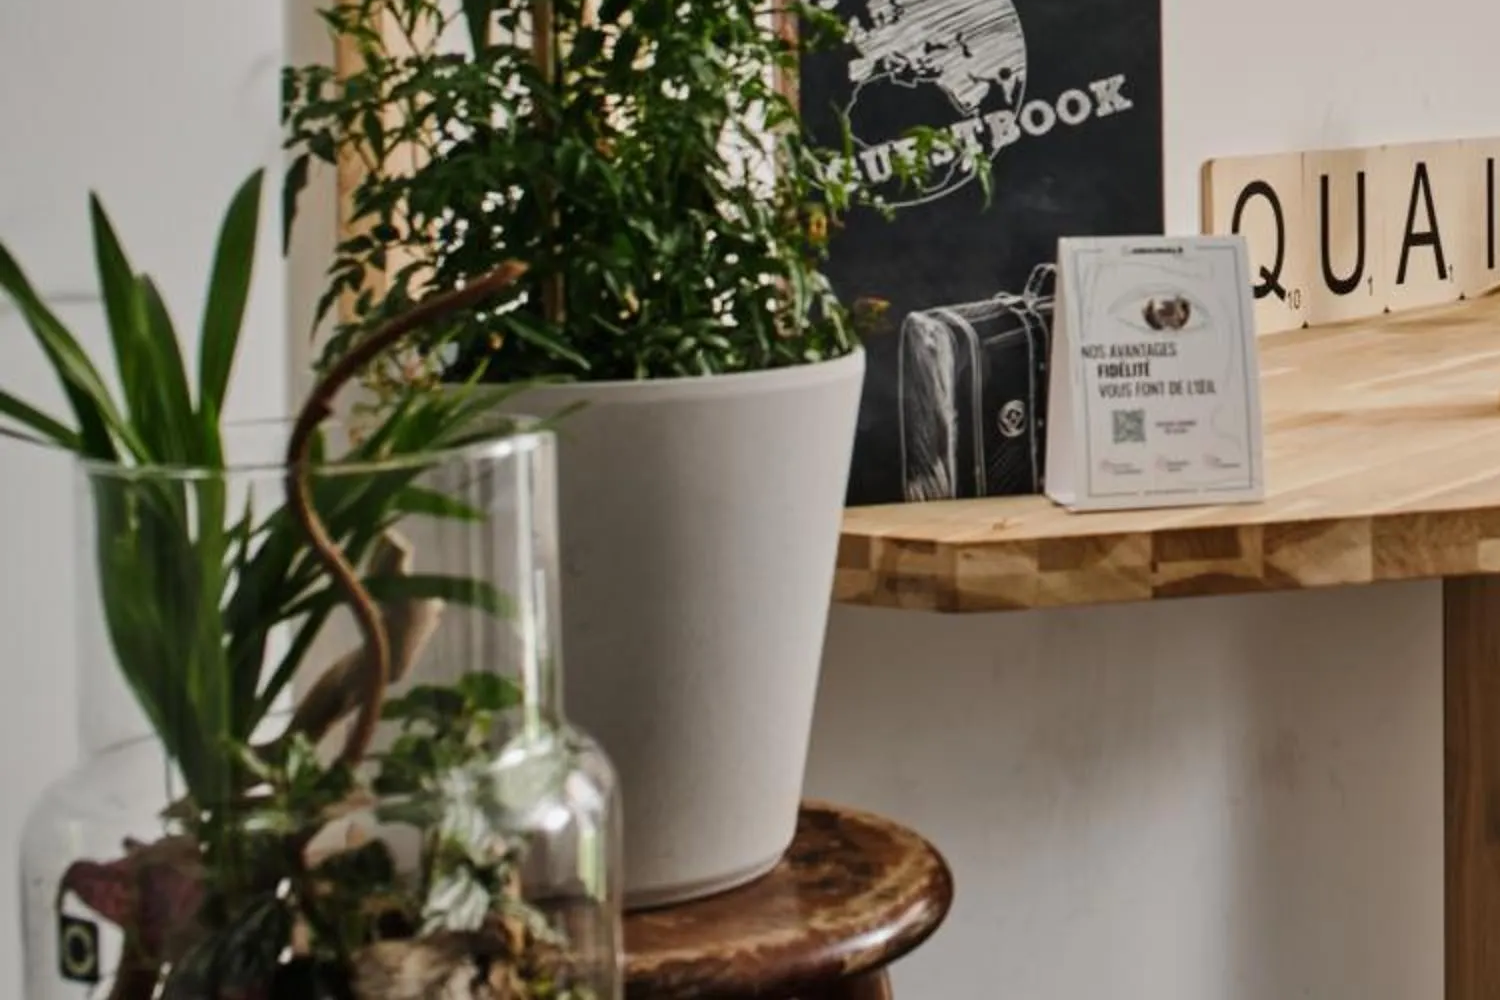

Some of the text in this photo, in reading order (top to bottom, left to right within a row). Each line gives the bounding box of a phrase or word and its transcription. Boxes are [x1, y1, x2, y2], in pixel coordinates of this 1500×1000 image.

[1231, 157, 1495, 301] QUAI
[1081, 342, 1177, 358] NOS AVANTAGES
[1098, 382, 1132, 398] VOUS
[1135, 380, 1164, 396] FONT
[1169, 380, 1183, 395] DE
